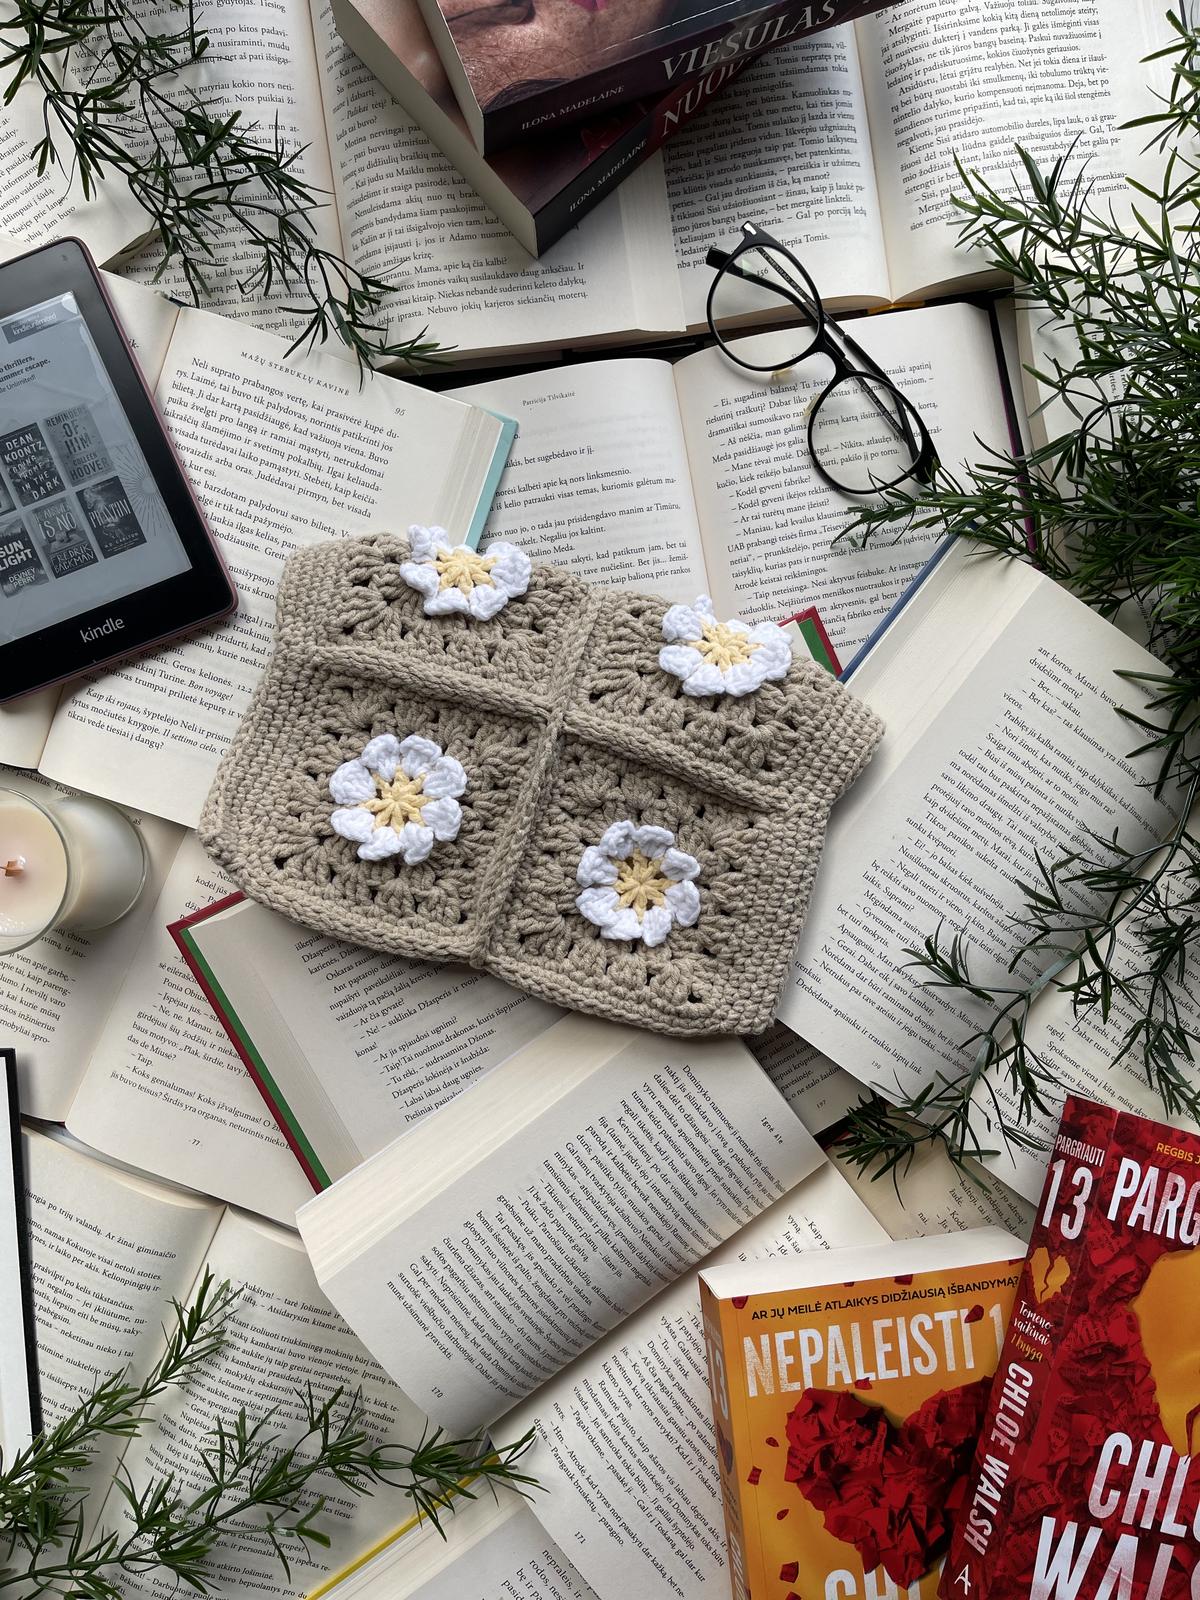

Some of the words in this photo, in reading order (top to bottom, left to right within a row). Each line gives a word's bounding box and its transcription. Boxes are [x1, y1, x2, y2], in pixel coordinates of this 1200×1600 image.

[217, 38, 265, 47] nusiraminti,
[267, 41, 290, 51] mudu
[661, 0, 838, 80] VIESULAS
[198, 81, 229, 95] patyriau
[231, 79, 255, 88] kokio
[277, 83, 294, 91] neti-
[521, 112, 557, 131] ILONA
[559, 85, 625, 115] MADELAINE
[569, 183, 598, 212] ILONA
[598, 139, 647, 186] MADELAINE
[756, 267, 768, 276] 156
[427, 305, 458, 315] Nebuvo
[461, 301, 481, 312] jokių
[483, 300, 514, 309] karjeros
[517, 294, 555, 305] siekiančių
[558, 291, 588, 300] moterų.
[4, 356, 35, 371] thrillers,
[25, 359, 51, 372] escape.
[240, 351, 266, 366] MAŽŲ
[268, 361, 314, 384] STEBUKLŲ
[316, 379, 349, 396] KAVINĖ
[191, 357, 208, 369] Neli
[210, 366, 240, 381] suprato
[241, 377, 284, 397] prabangos
[286, 393, 307, 406] vertę,
[311, 400, 324, 412] kai
[325, 408, 362, 426] prasivėrė
[363, 419, 384, 434] kupė
[386, 428, 399, 438] du-
[47, 406, 89, 428] REMINDERS
[62, 419, 81, 437] OF
[4, 441, 45, 463] KOONTZ
[5, 433, 33, 450] DEAN
[65, 433, 91, 455] HIM
[12, 455, 37, 473] GOING
[18, 463, 43, 479] HOME
[71, 457, 113, 480] HOOVER
[73, 452, 98, 465] COLLEEN
[22, 483, 31, 492] IN
[33, 472, 50, 486] THE
[32, 477, 60, 500] DARK
[494, 486, 516, 497] norėsi
[517, 481, 541, 493] kalbėti
[543, 479, 557, 490] apie
[558, 477, 568, 486] ką
[569, 475, 585, 483] nors
[586, 467, 631, 480] linksmesnio.
[735, 485, 757, 497] Kodėl
[758, 481, 782, 494] gyveni
[783, 475, 811, 487] fabrike?
[39, 519, 55, 539] IS
[56, 511, 77, 530] NO
[88, 498, 131, 528] PHANTOM
[0, 548, 33, 570] LIGHT
[50, 543, 91, 566] FREDRIK
[54, 552, 94, 574] BACKMAN
[8, 567, 36, 584] DEVNEY
[13, 575, 36, 588] PERRY
[79, 616, 125, 643] kindle
[187, 679, 204, 691] Bon
[204, 687, 233, 701] voyage!
[67, 710, 86, 723] tikrai
[87, 718, 105, 729] vedė
[106, 724, 130, 738] tiesiai
[134, 733, 164, 750] dangų?
[862, 870, 881, 889] laikis.
[882, 886, 914, 912] Supranti?
[836, 903, 848, 916] bet
[848, 914, 862, 926] turi
[861, 924, 888, 947] mokytis.
[360, 1017, 368, 1026] Ar
[369, 1012, 380, 1020] čia
[380, 997, 404, 1017] gyvatė?
[127, 1034, 139, 1044] das
[139, 1041, 149, 1049] de
[149, 1044, 176, 1060] Miusė?
[1046, 1040, 1080, 1069] Spoksome
[1081, 1067, 1098, 1083] viena
[1102, 1082, 1115, 1097] kitą,
[404, 1093, 424, 1107] Labai
[423, 1084, 441, 1098] labai
[442, 1077, 460, 1089] daug
[459, 1065, 484, 1080] ugnies.
[191, 1138, 200, 1146] 77
[1055, 1134, 1105, 1167] PARGRIAUTI
[1156, 1142, 1193, 1161] REGBIS
[1042, 1158, 1094, 1240] 13
[47, 1202, 57, 1211] po
[59, 1208, 73, 1221] trijų
[75, 1217, 102, 1236] valandų.
[105, 1232, 115, 1240] Ar
[116, 1236, 135, 1248] žinai
[135, 1245, 176, 1258] giminaičio
[752, 1310, 767, 1320] AR
[770, 1307, 785, 1320] JŲ
[787, 1301, 822, 1316] MEILĖ
[824, 1296, 879, 1311] ATLAIKYS
[881, 1289, 945, 1305] DIDŽIAUSIĄ
[947, 1275, 1019, 1295] IŠBANDYMĄ?
[387, 1281, 404, 1300] munė
[402, 1300, 430, 1332] užsimanė
[425, 1331, 453, 1360] pravirkti.
[1020, 1300, 1052, 1330] Tomeno
[1013, 1316, 1051, 1345] vaikinai
[743, 1308, 975, 1397] NEPALEISTI
[431, 1386, 443, 1398] 170
[601, 1361, 619, 1388] kikeno
[617, 1387, 632, 1410] vyras.
[991, 1362, 1034, 1455] CHLOE
[1088, 1432, 1200, 1540] CHL
[963, 1453, 1009, 1555] WALSH
[574, 1531, 586, 1544] 171
